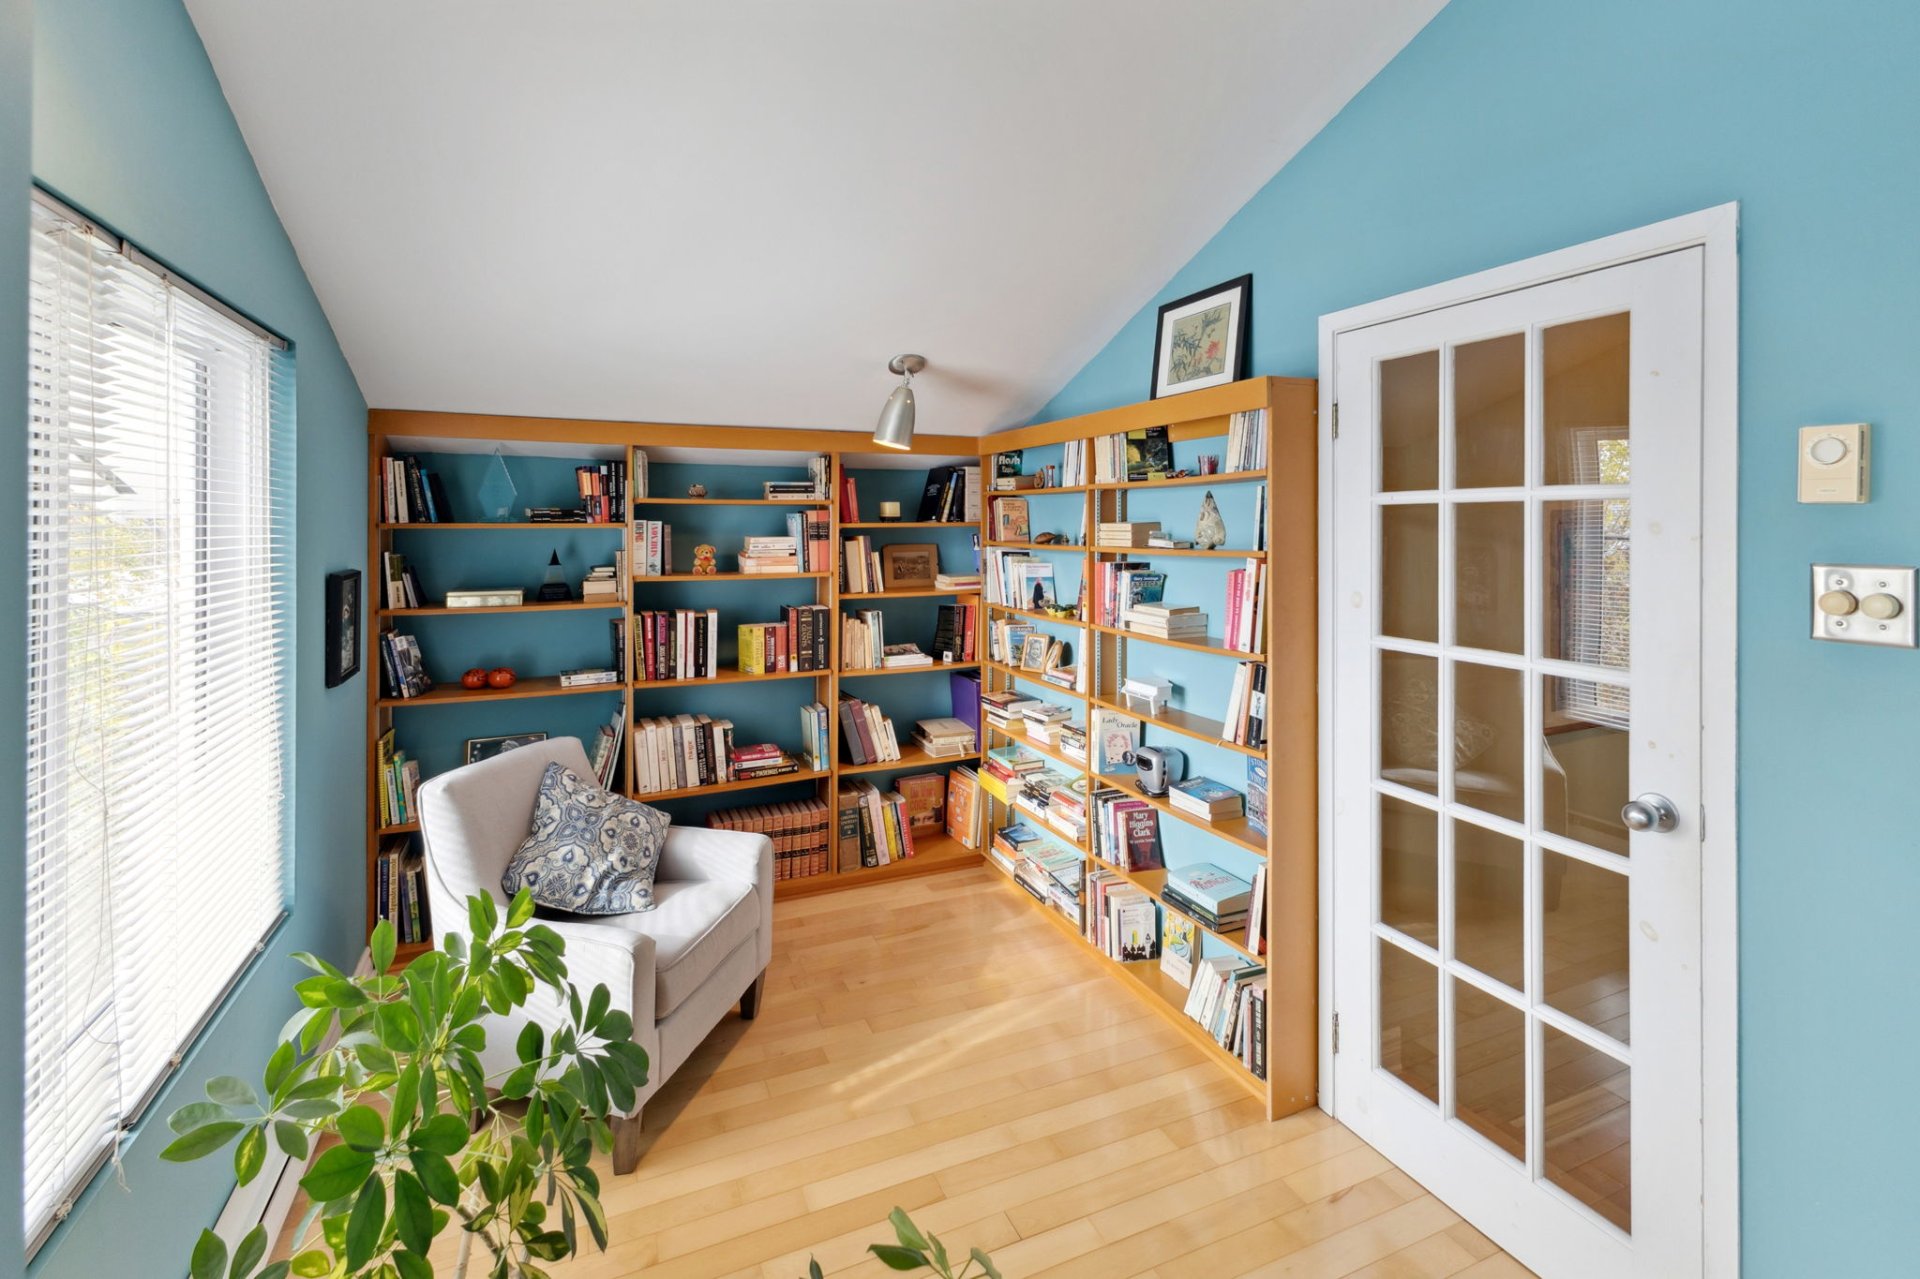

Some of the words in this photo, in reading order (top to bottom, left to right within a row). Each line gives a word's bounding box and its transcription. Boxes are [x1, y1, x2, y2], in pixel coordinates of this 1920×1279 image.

[1102, 717, 1118, 725] Lady
[1133, 812, 1148, 820] Mary
[1129, 820, 1154, 829] Higgins
[1133, 829, 1150, 837] Clark
